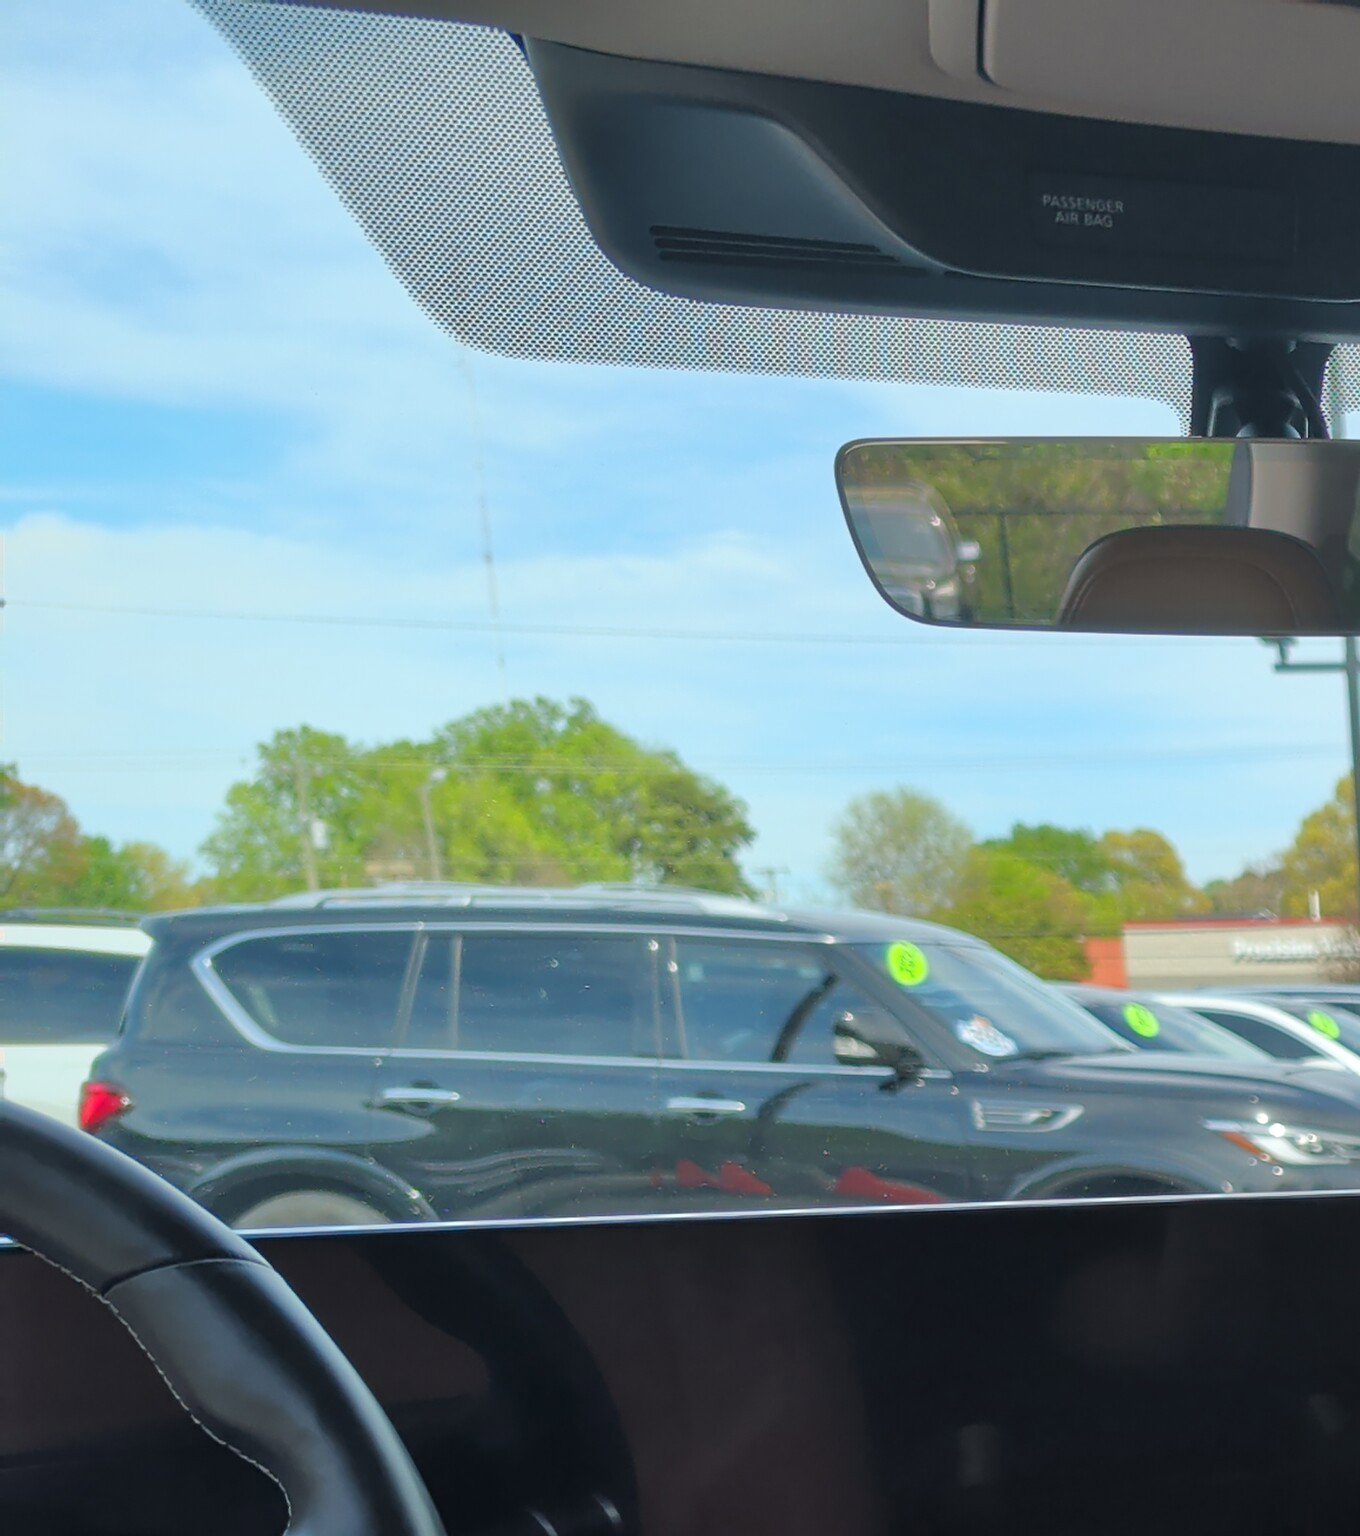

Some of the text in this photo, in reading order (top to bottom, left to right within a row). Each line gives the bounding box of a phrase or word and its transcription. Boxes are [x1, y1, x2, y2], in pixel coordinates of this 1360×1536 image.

[1042, 194, 1124, 213] PASSENGER
[1055, 211, 1113, 228] AIR BAG
